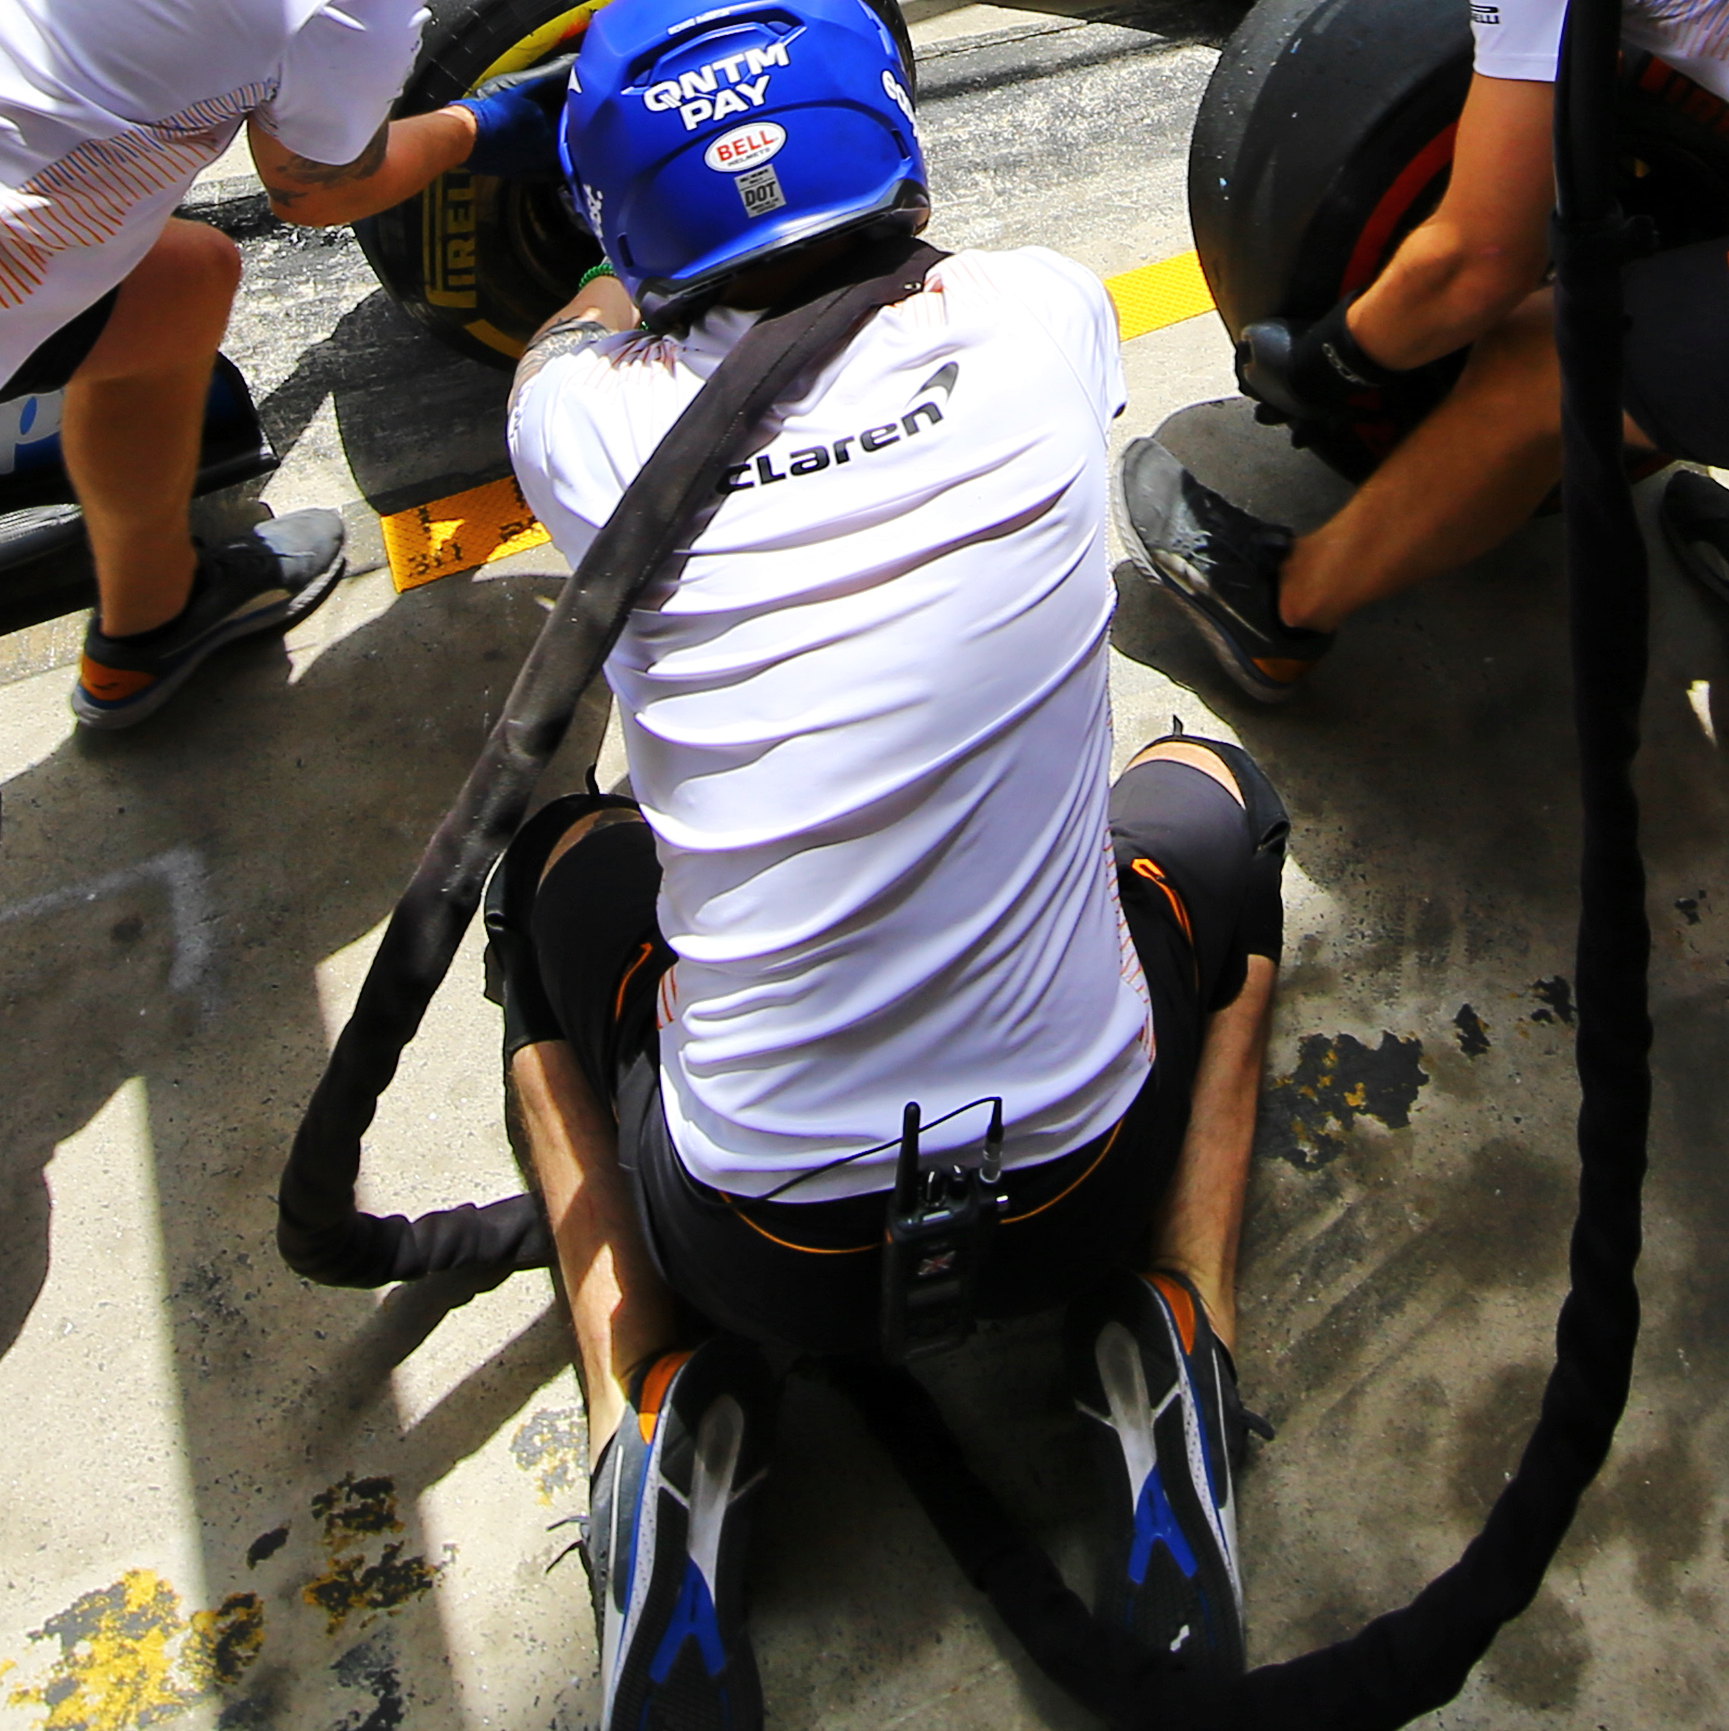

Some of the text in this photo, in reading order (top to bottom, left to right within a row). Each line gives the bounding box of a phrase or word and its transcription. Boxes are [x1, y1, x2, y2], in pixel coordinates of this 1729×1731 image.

[643, 42, 791, 113] QNTM
[680, 75, 771, 132] PAY
[716, 130, 776, 162] BELL
[744, 181, 777, 208] DOT
[716, 400, 944, 495] cLaren
